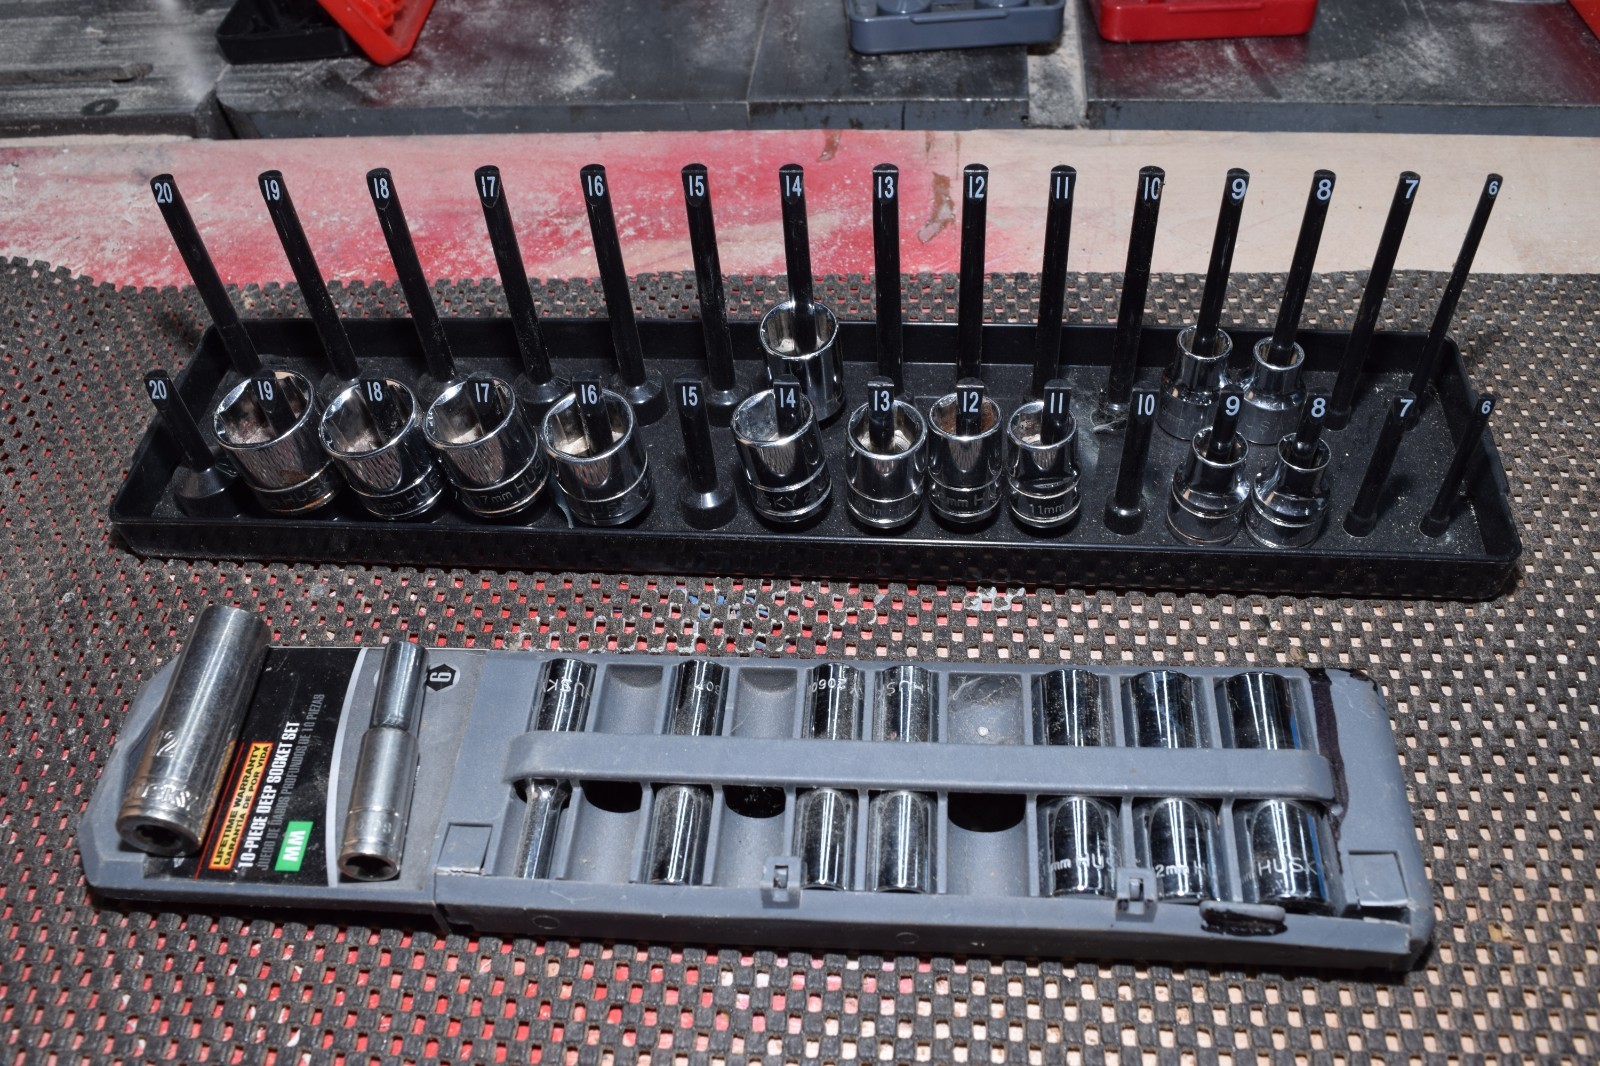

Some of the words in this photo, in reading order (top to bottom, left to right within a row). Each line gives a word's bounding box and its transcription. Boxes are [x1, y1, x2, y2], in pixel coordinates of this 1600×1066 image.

[154, 182, 173, 204] 20
[264, 179, 280, 201] 19
[373, 177, 390, 199] 18
[481, 175, 496, 198] 17
[587, 175, 604, 197] 16
[688, 175, 705, 197] 15
[785, 175, 803, 197] 14
[877, 175, 895, 199] 13
[968, 175, 985, 199] 12
[1055, 176, 1069, 200] 11
[1144, 176, 1161, 201] 10
[1231, 178, 1248, 200] 9
[1316, 178, 1333, 201] 8
[1405, 179, 1419, 199] 7
[1488, 180, 1499, 196] 6
[148, 379, 167, 400] 20
[257, 380, 274, 401] 19
[367, 381, 383, 402] 18
[475, 382, 490, 403] 17
[581, 384, 598, 405] 16
[682, 385, 698, 407] 15
[779, 387, 797, 408] 14
[874, 390, 891, 412] 13
[962, 391, 979, 413] 12
[1050, 392, 1064, 414] 11
[1137, 393, 1155, 416] 10
[1225, 395, 1241, 416] 9
[1310, 397, 1326, 418] 8
[1399, 398, 1414, 418] 7
[1481, 400, 1492, 415] 6
[429, 671, 452, 683] 6
[305, 693, 325, 721] PIEZAS
[281, 720, 300, 741] SET
[302, 721, 315, 733] 10
[299, 734, 310, 745] DE
[266, 742, 294, 784] SOCKET
[282, 745, 308, 795] PROFUNDOS
[213, 810, 239, 866] LIFETIME
[231, 745, 260, 808] WARRANTY
[223, 813, 247, 867] GARANTÍA
[242, 795, 253, 809] DE
[248, 771, 262, 792] POR
[256, 745, 270, 768] VIDA
[256, 785, 277, 814] DEEP
[237, 816, 267, 870] 10-PIECE
[266, 827, 280, 839] DE
[257, 840, 275, 871] JUEGO
[282, 830, 307, 862] MM
